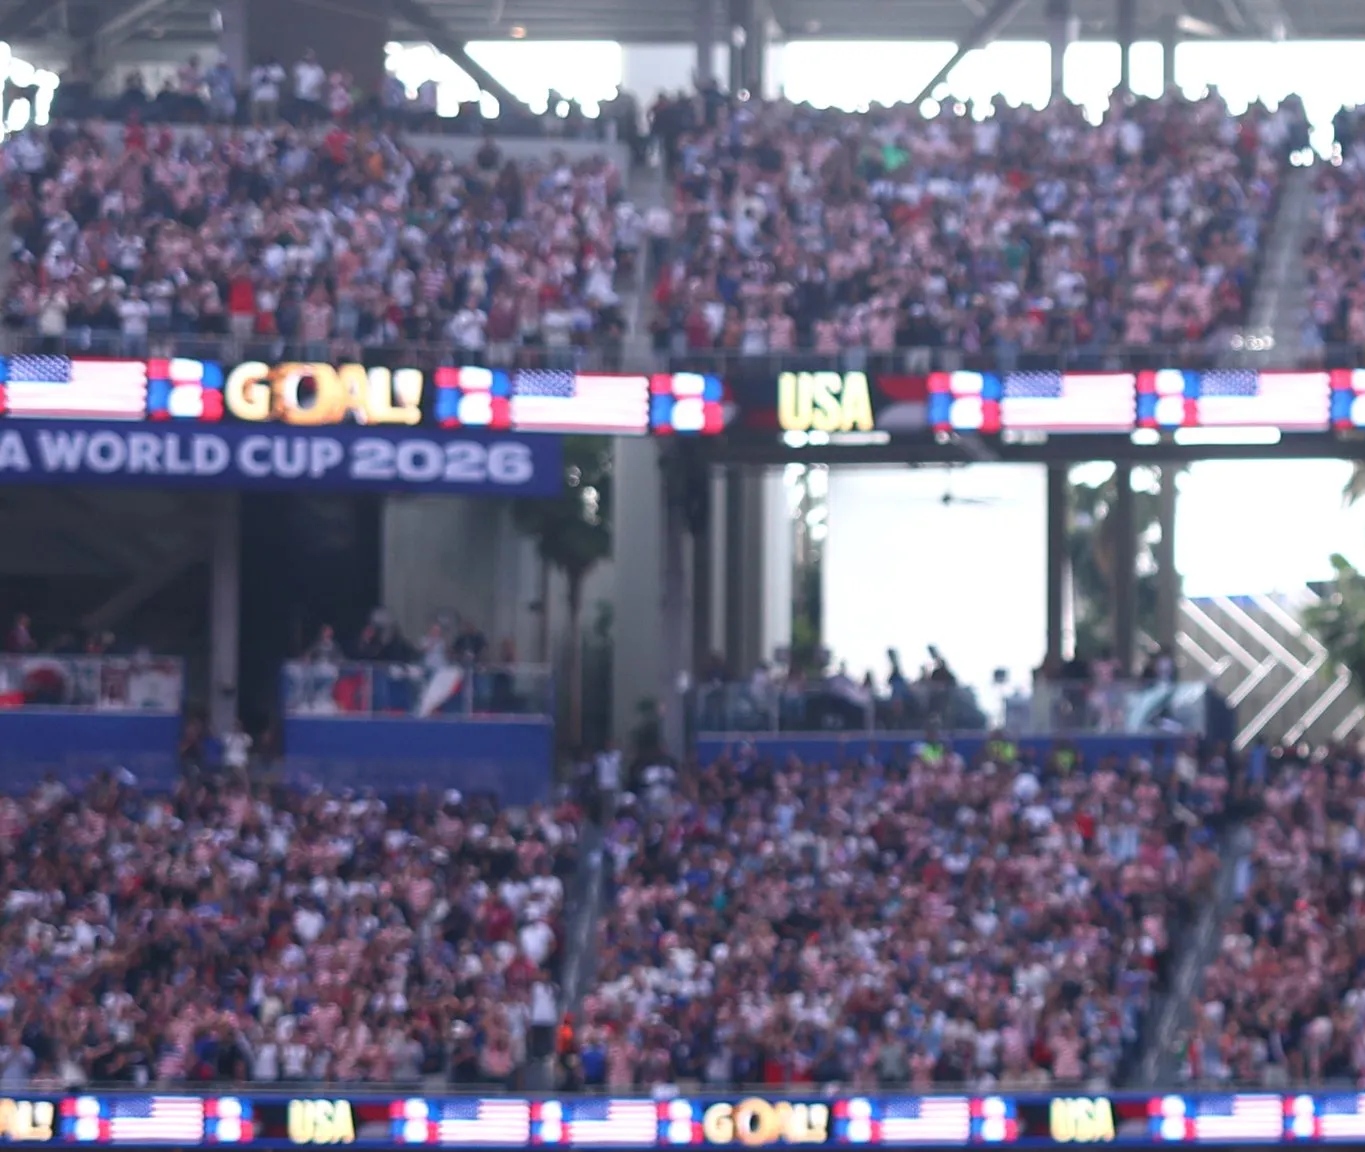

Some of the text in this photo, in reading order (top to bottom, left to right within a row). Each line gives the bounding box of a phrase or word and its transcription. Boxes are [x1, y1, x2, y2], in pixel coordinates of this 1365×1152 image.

[225, 361, 423, 425] GOAL!
[778, 372, 873, 432] USA
[37, 429, 230, 476] WORLD
[237, 435, 344, 479] CUP
[350, 441, 533, 482] 2026
[287, 1098, 356, 1144] USA
[703, 1098, 829, 1146] GOAL!
[1049, 1097, 1115, 1144] USA
